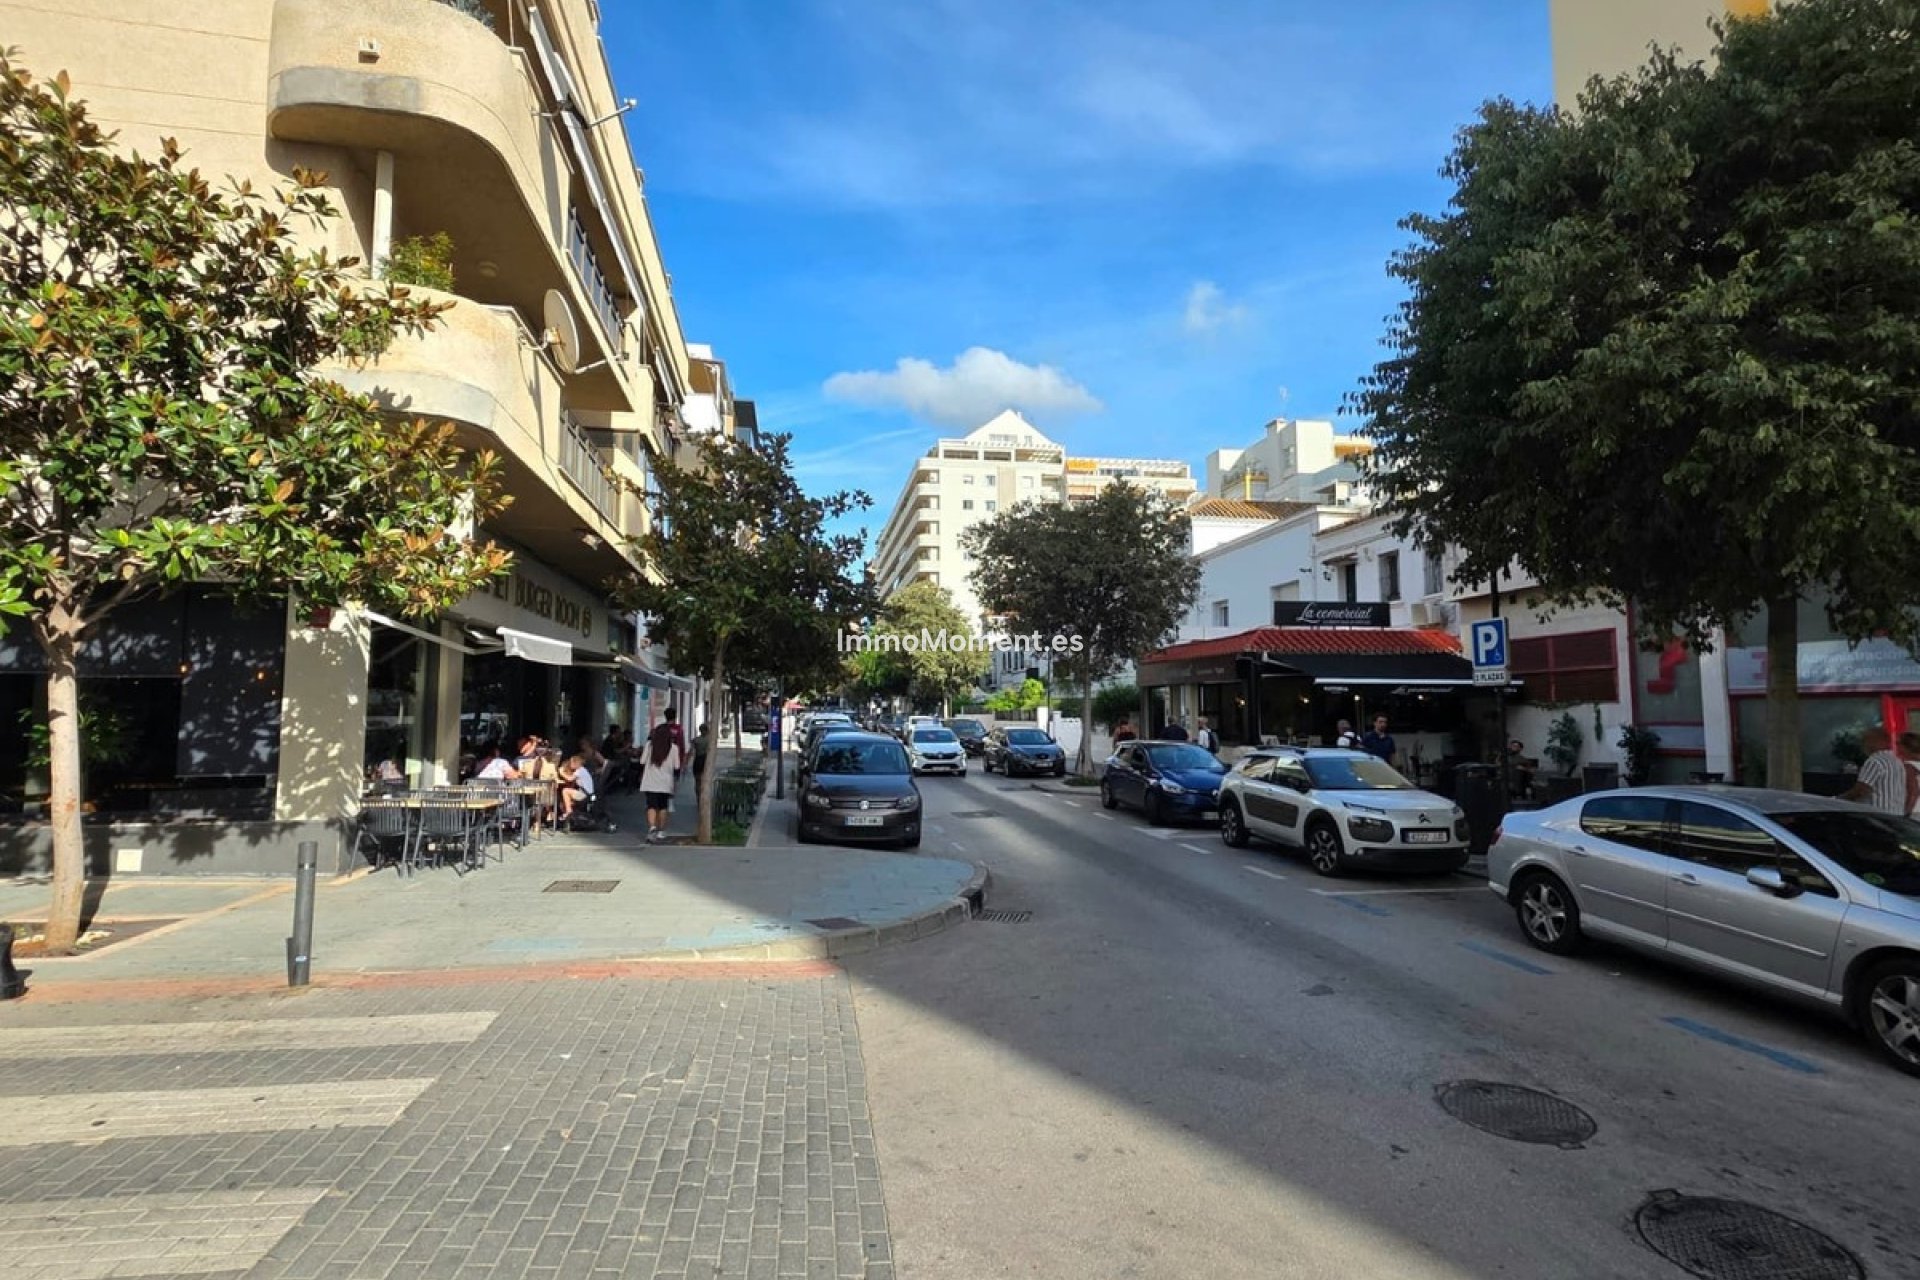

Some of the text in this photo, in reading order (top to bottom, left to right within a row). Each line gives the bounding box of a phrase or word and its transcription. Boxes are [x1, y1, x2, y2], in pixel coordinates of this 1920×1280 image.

[515, 574, 553, 620] BURGER
[554, 593, 580, 631] ROOM
[1317, 606, 1374, 620] comercial
[1478, 625, 1498, 663] P
